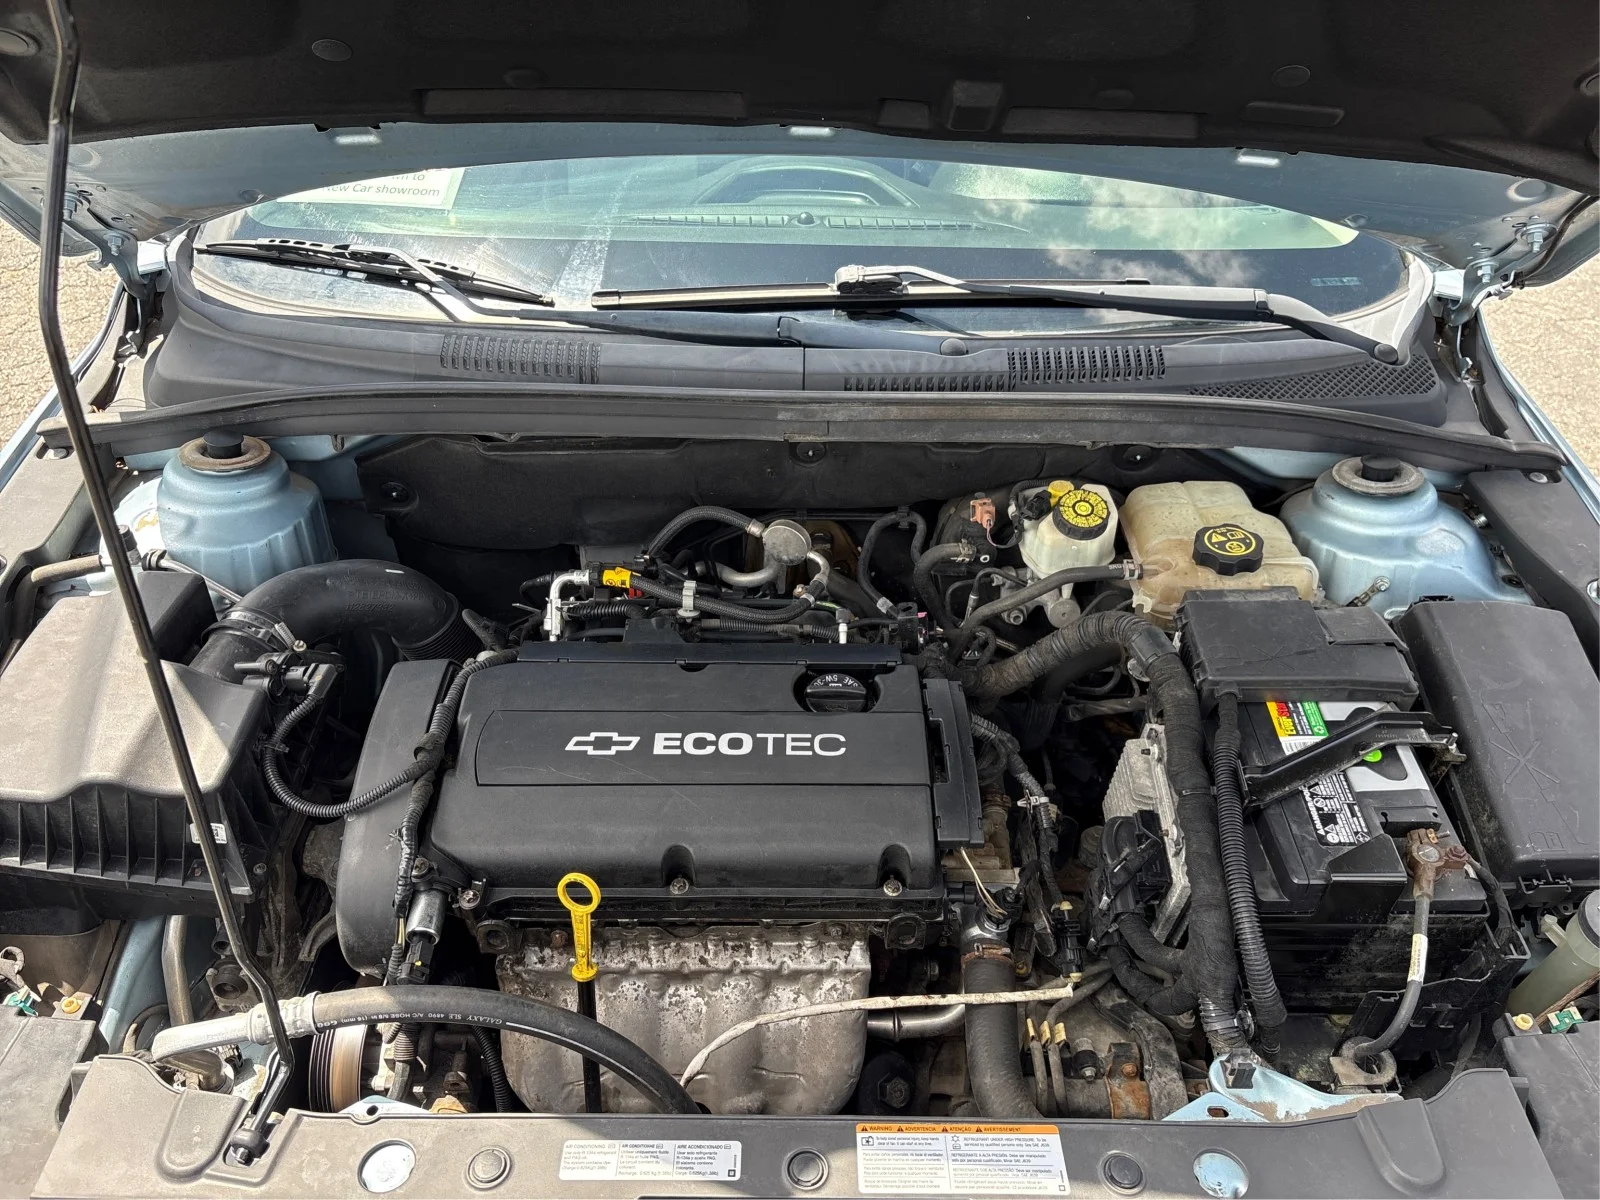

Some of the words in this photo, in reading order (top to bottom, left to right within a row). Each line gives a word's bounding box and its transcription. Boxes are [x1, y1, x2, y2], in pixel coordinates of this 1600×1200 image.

[352, 183, 374, 193] Car
[375, 184, 440, 197] showroom
[842, 676, 859, 687] SAE
[653, 732, 847, 757] ECOTEC
[466, 1014, 502, 1024] GALAXY
